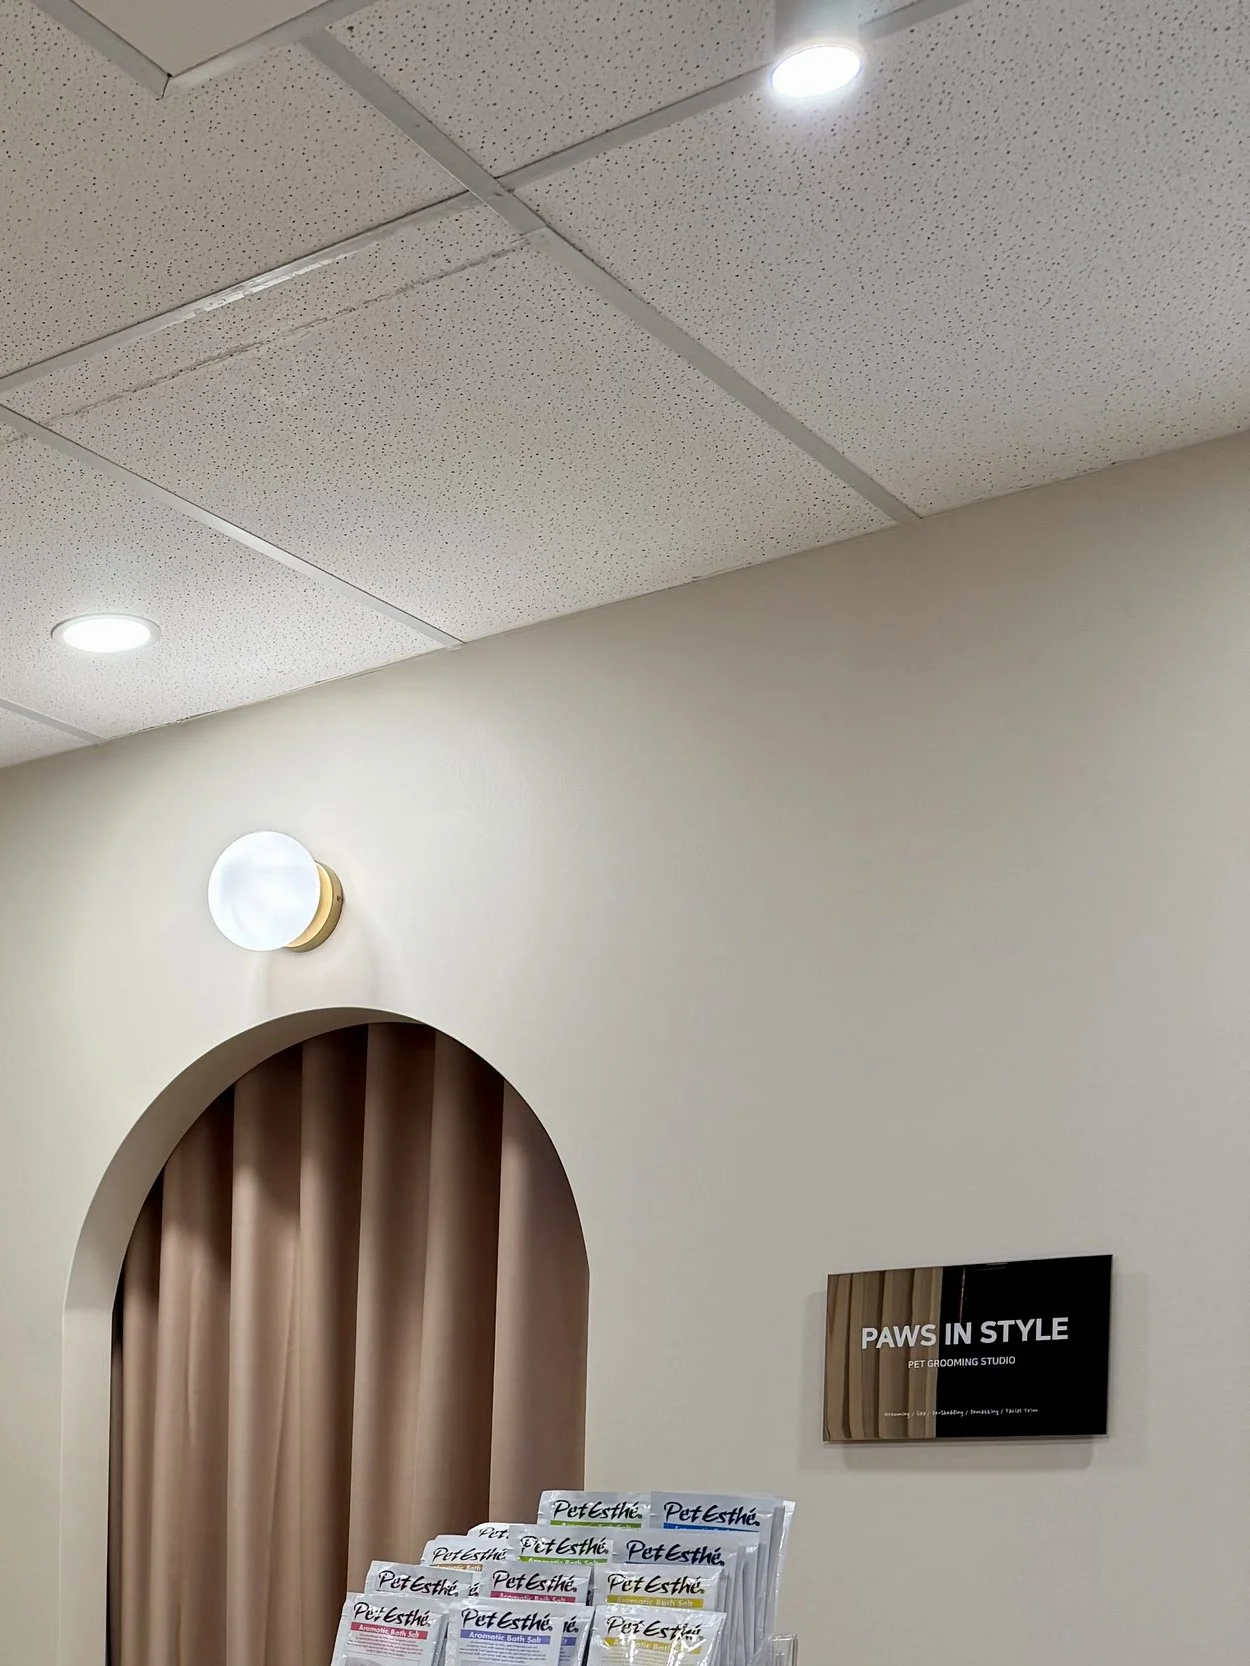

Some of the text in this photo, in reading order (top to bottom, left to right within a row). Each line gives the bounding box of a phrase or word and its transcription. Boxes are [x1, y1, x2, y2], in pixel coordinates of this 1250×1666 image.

[862, 1317, 1069, 1349] PAWS IN STYLE
[908, 1356, 1016, 1369] PET GROOMING STUDIO
[553, 1499, 588, 1519] Pet
[663, 1501, 702, 1522] Pet
[433, 1547, 461, 1563] Pet
[520, 1535, 554, 1556] Pet
[626, 1539, 662, 1562] Pet
[378, 1569, 410, 1590] Pet
[492, 1569, 523, 1590] Pet
[607, 1573, 645, 1593] Pet
[353, 1601, 386, 1621] Pet
[678, 1600, 694, 1608] Salt
[461, 1608, 496, 1628] Pet
[359, 1624, 420, 1639] Aromatic Bath Salt
[469, 1632, 542, 1644] Aromatic Bath Salt
